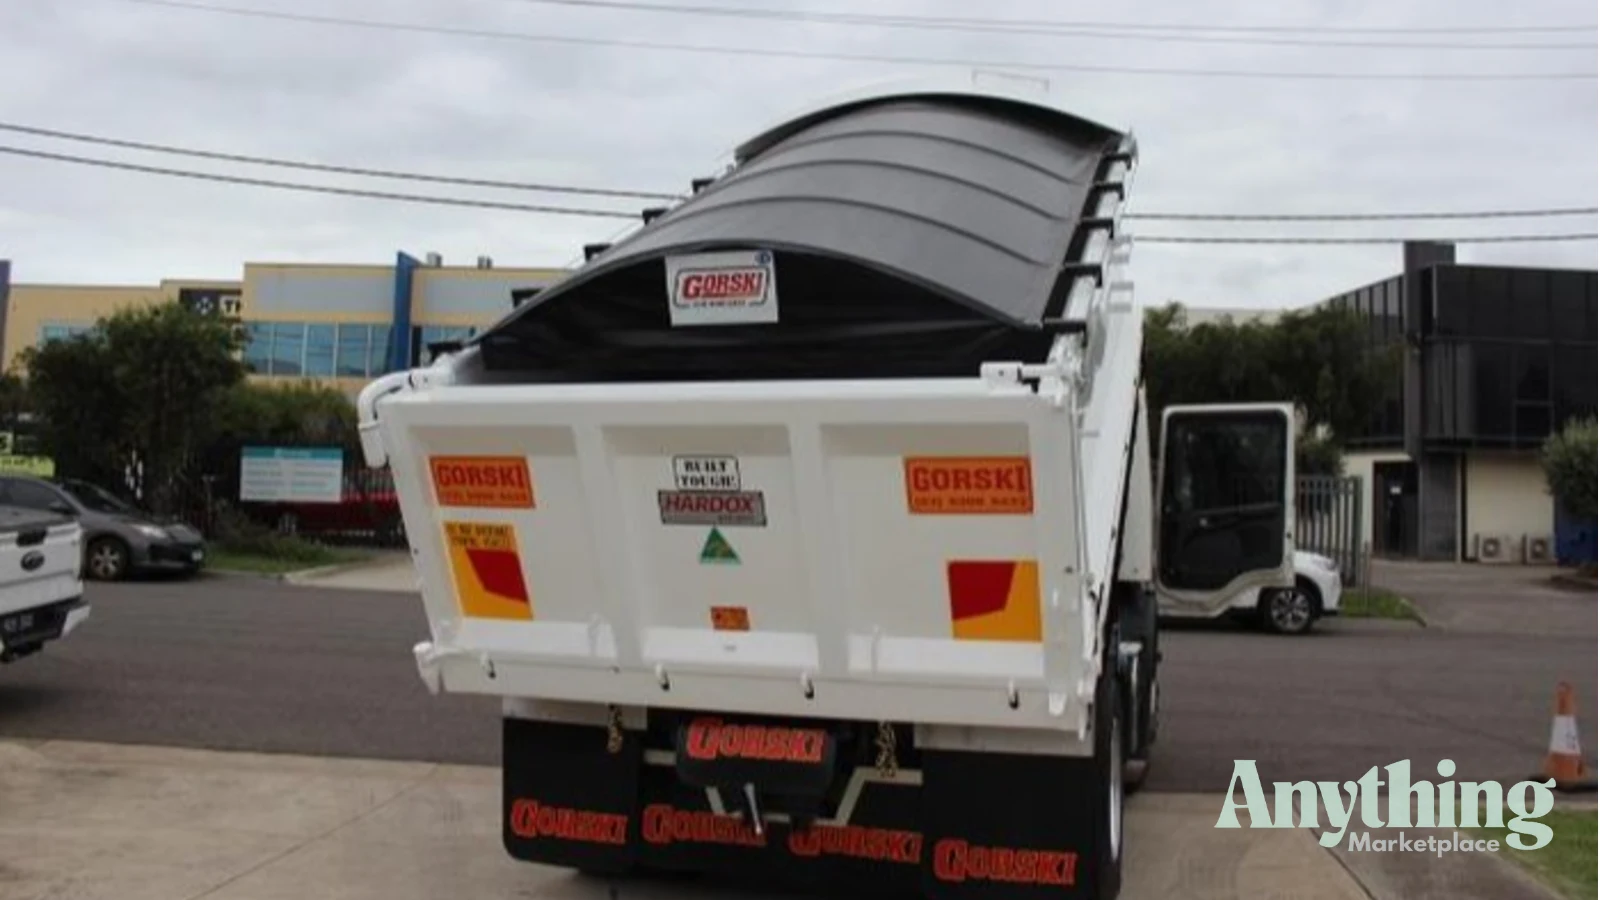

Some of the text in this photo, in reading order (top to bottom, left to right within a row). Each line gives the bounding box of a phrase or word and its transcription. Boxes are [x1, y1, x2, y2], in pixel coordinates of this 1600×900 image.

[682, 272, 764, 299] GORSKI
[438, 465, 525, 488] GORSKI
[912, 465, 1026, 492] GORSKI
[664, 495, 754, 513] HARDOX
[687, 717, 827, 762] GORSKI
[511, 798, 628, 844] GORSKI
[933, 838, 1078, 885] GORSKI
